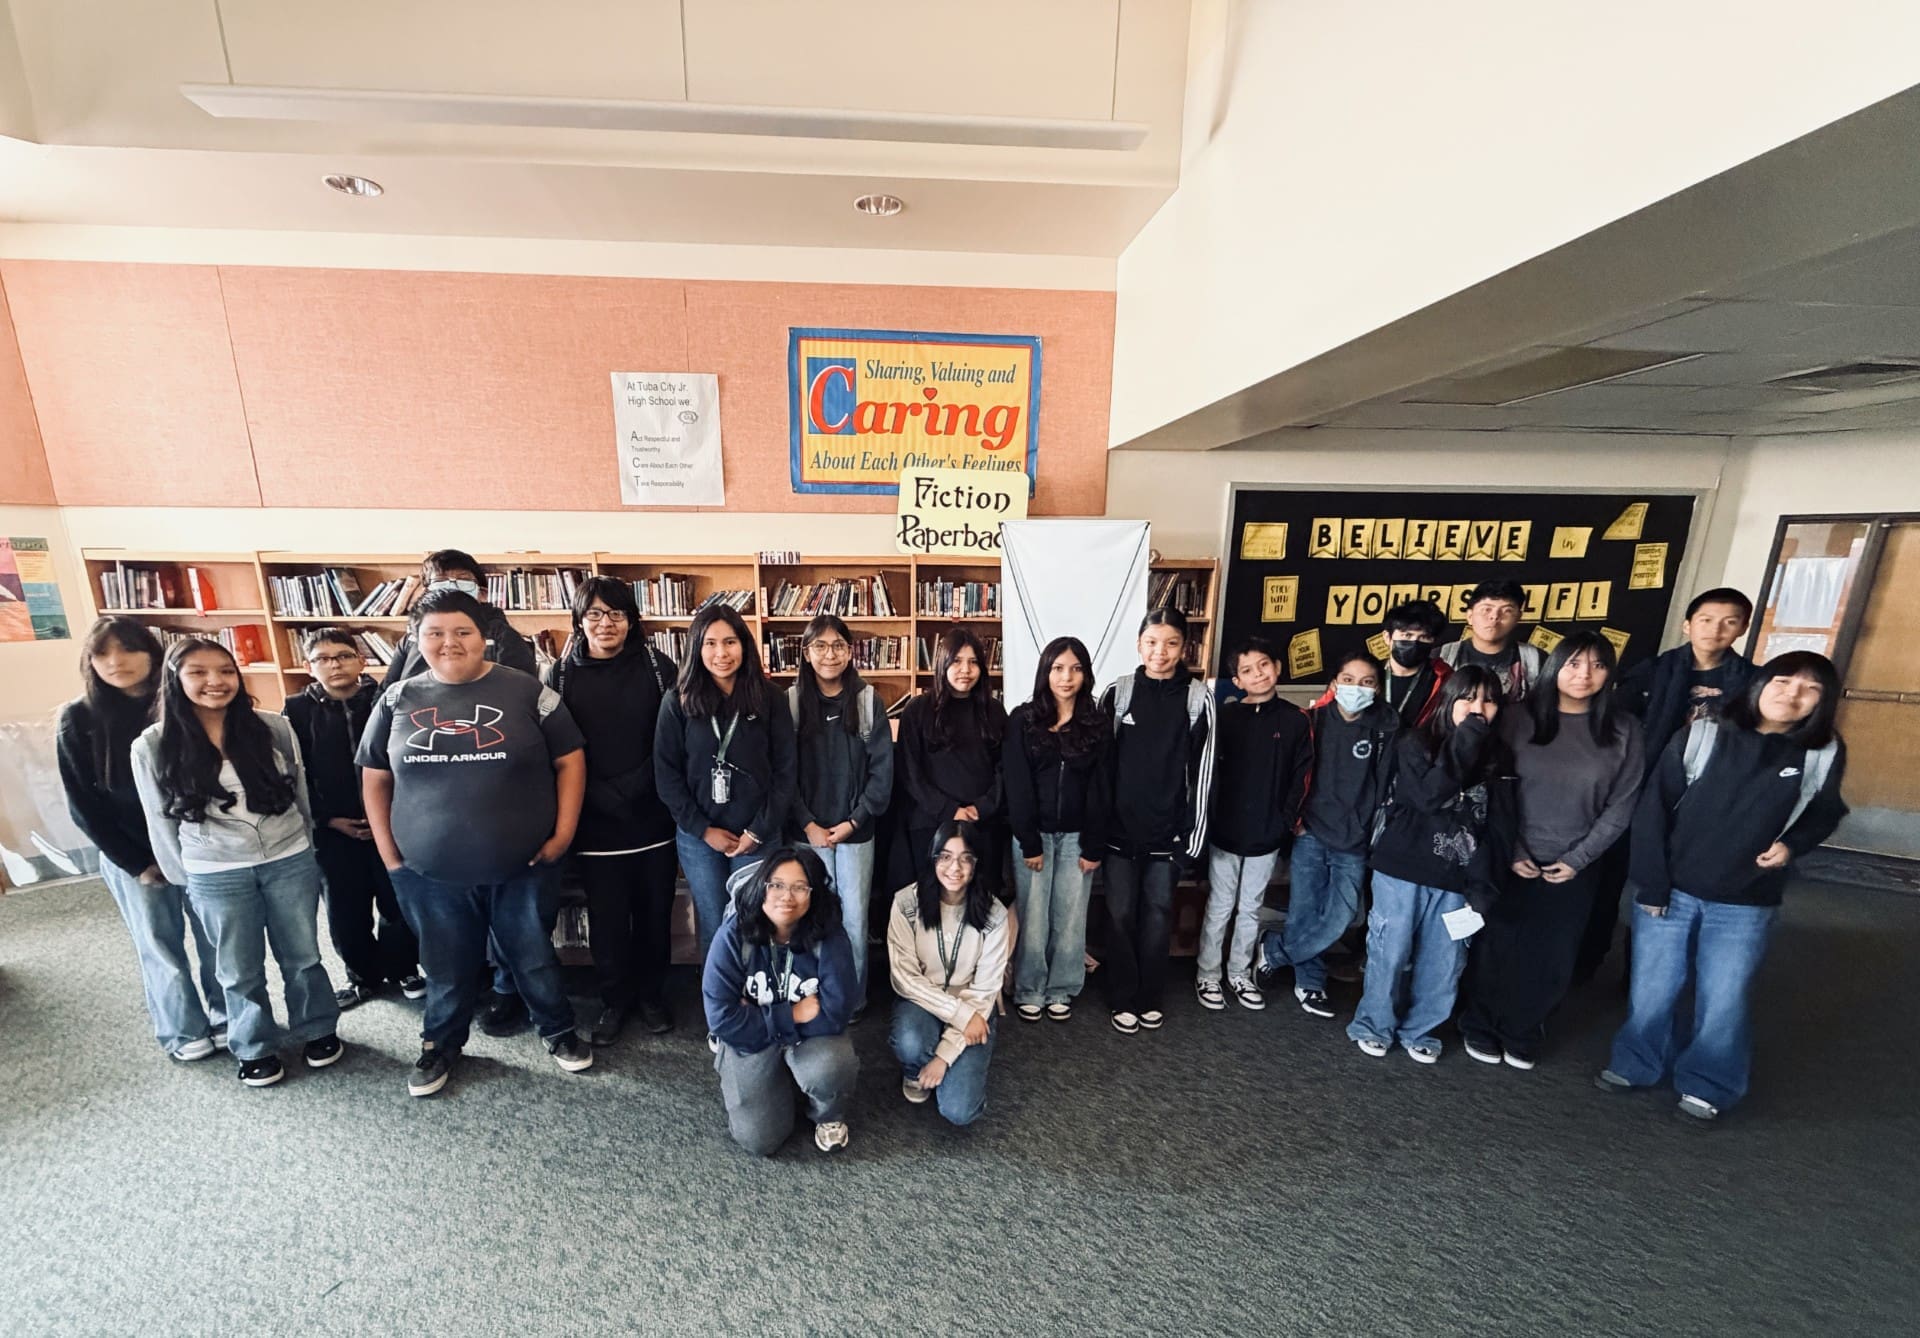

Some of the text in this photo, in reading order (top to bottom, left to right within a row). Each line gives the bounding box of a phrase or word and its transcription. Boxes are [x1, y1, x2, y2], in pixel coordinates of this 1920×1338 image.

[865, 359, 1017, 388] Sharing, Valuing and
[636, 381, 659, 391] Tuba
[660, 381, 676, 394] City
[627, 396, 647, 407] High
[648, 396, 676, 406] School
[809, 364, 1021, 450] Caring
[810, 449, 856, 471] About
[860, 451, 898, 471] Each
[903, 452, 957, 469] Other's
[914, 476, 1011, 513] Fiction
[1317, 523, 1522, 550] BELIEVE
[759, 551, 801, 564] FICTION
[403, 751, 507, 764] UNDER ARMOUR
